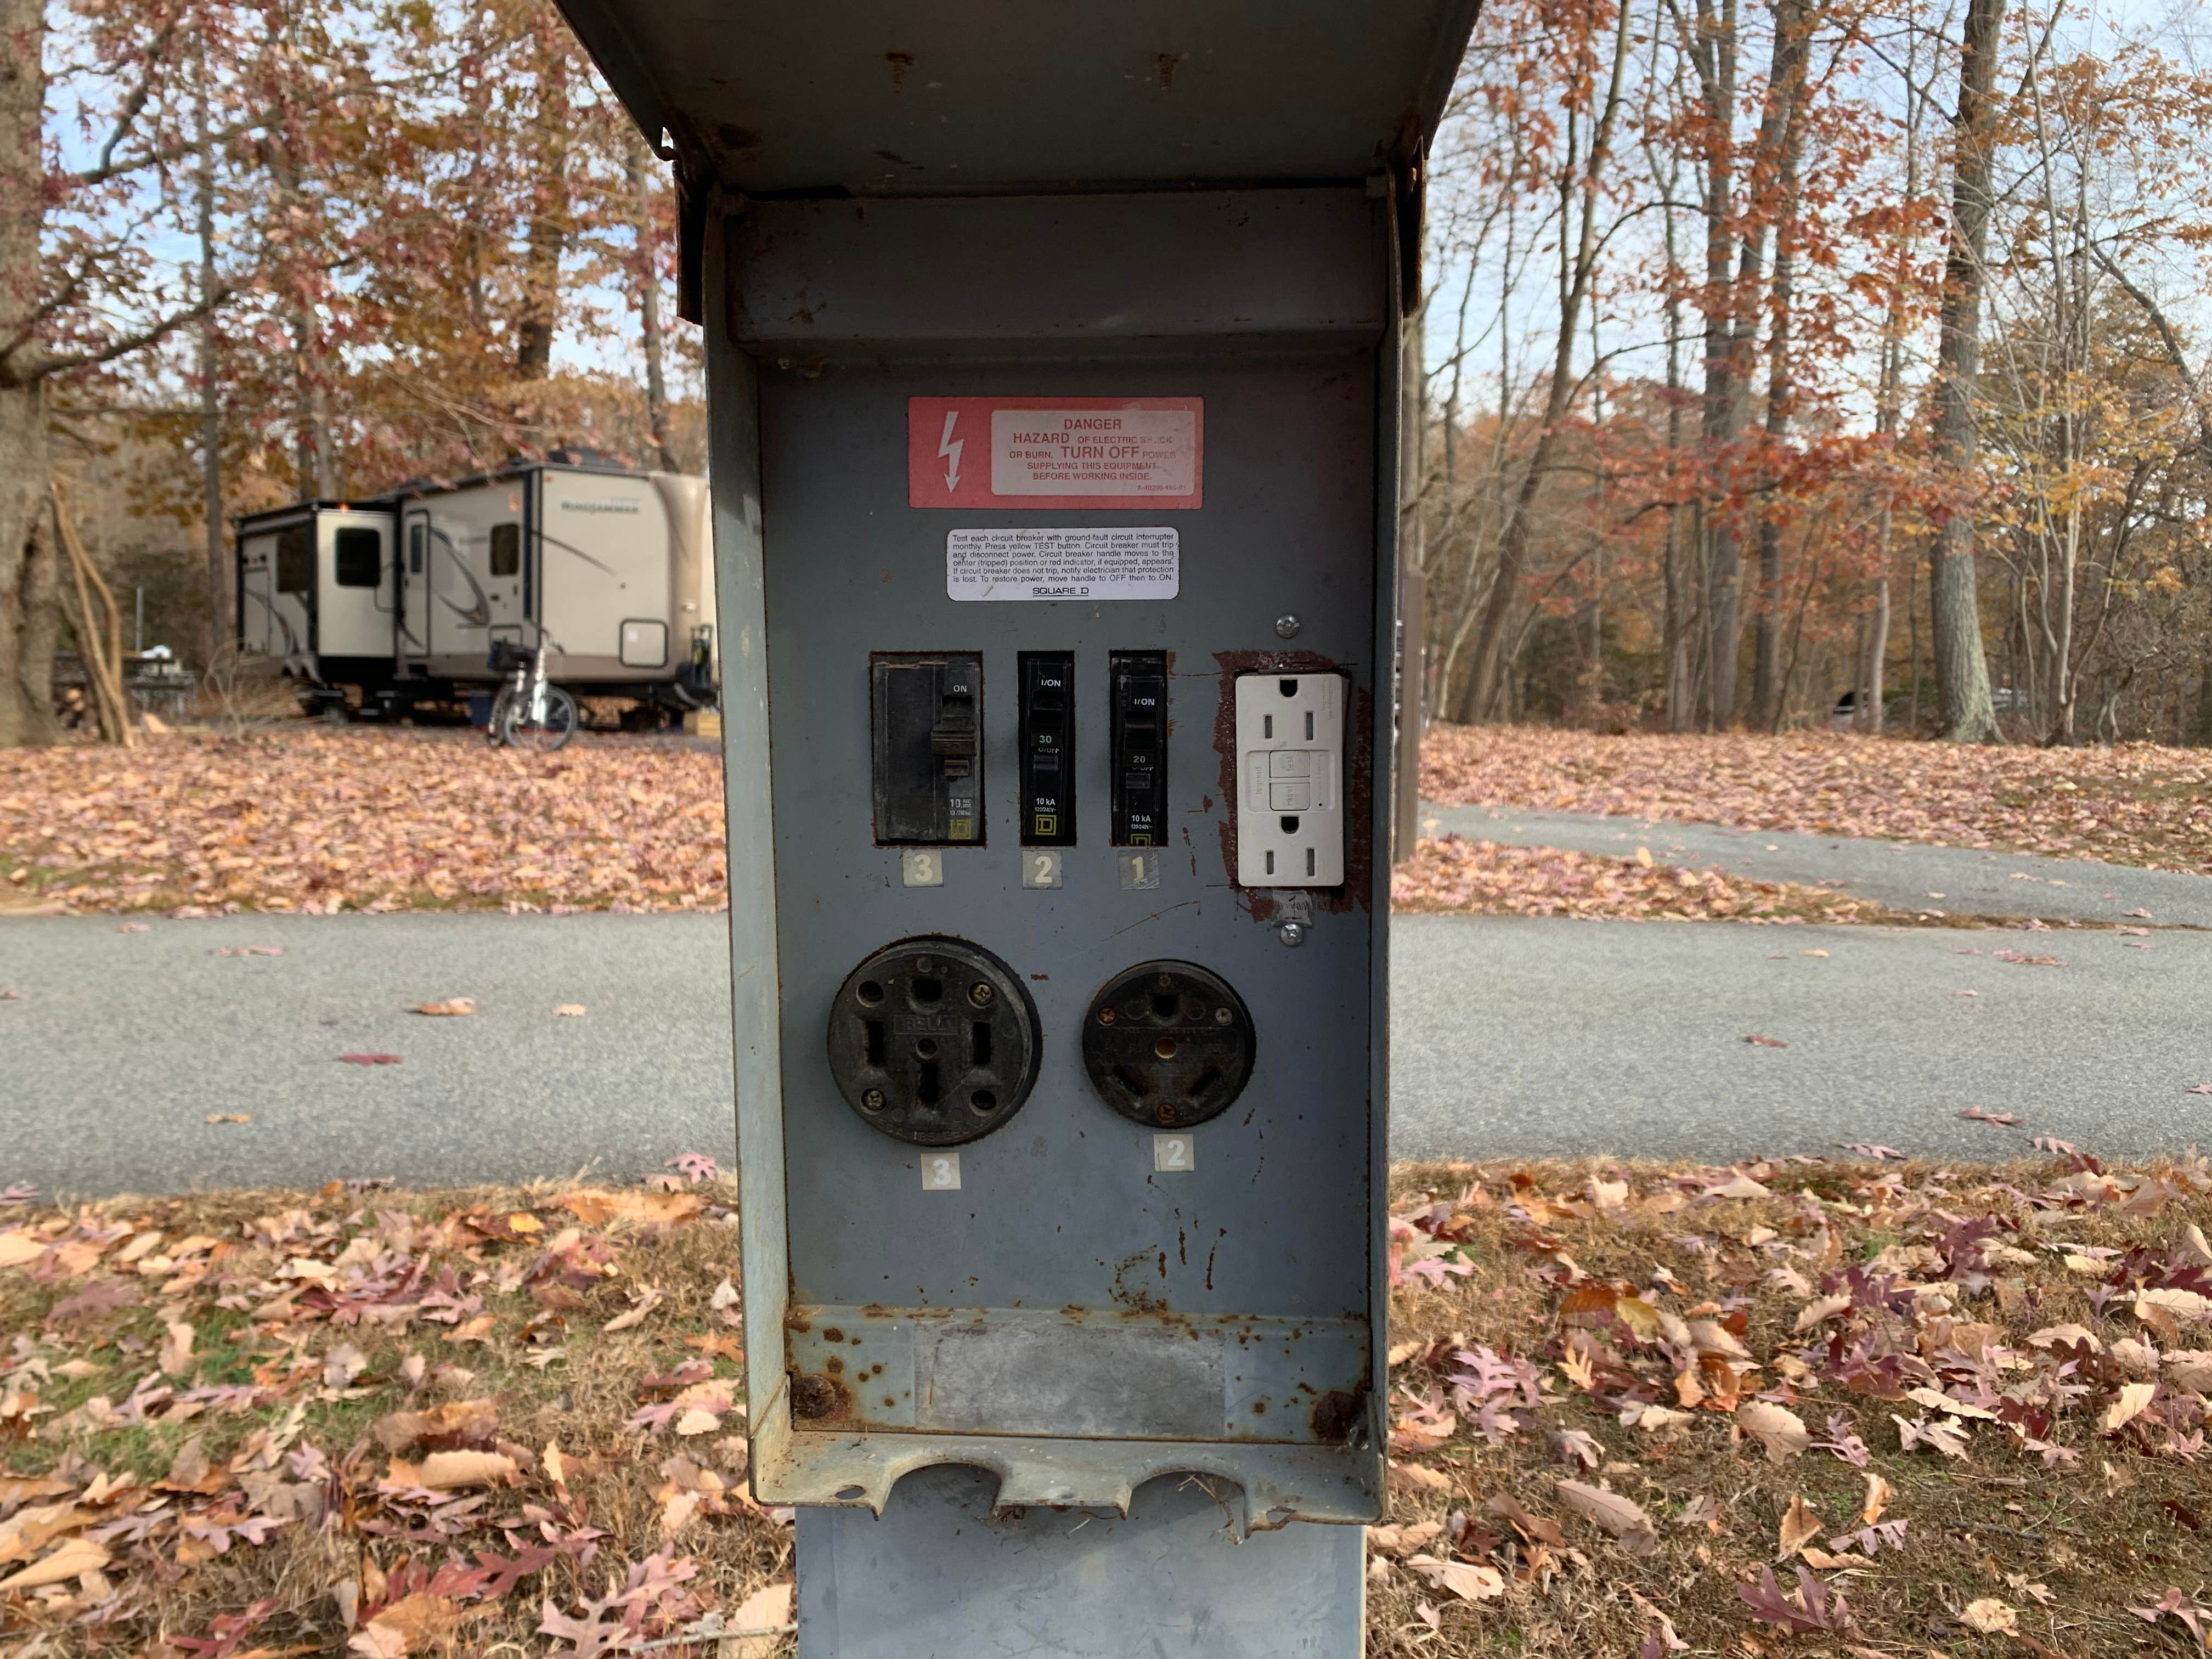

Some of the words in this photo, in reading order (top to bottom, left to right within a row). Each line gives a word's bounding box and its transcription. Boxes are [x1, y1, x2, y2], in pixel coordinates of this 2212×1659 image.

[1064, 419, 1122, 430] DANGER
[1013, 433, 1070, 444] HAZARD
[1060, 446, 1104, 459] TURN
[1109, 446, 1139, 459] OFF
[1142, 450, 1176, 459] POWER
[1026, 462, 1077, 470] SUPPLYING
[1081, 462, 1101, 470] THIS
[1103, 462, 1156, 470] EQUIPMENT
[1032, 472, 1070, 481] BEFORE
[1073, 472, 1117, 481] WORKING
[1065, 534, 1108, 543] ground-fault
[1136, 533, 1174, 542] interrupter
[953, 543, 982, 551] monthly.
[1009, 543, 1031, 551] yellow
[1163, 541, 1173, 549] trip
[978, 558, 1007, 567] (tripped)
[1010, 558, 1038, 567] position
[1063, 558, 1096, 567] indicator,
[1104, 557, 1139, 566] equipped,
[1046, 566, 1059, 575] trip,
[1062, 566, 1081, 575] notify
[1138, 566, 1173, 574] protection
[1039, 735, 1052, 743] 30
[913, 855, 933, 882] 3
[1034, 856, 1053, 883] 2
[1132, 856, 1148, 883] 1
[1167, 1140, 1186, 1166] 2
[933, 1159, 952, 1186] 3
